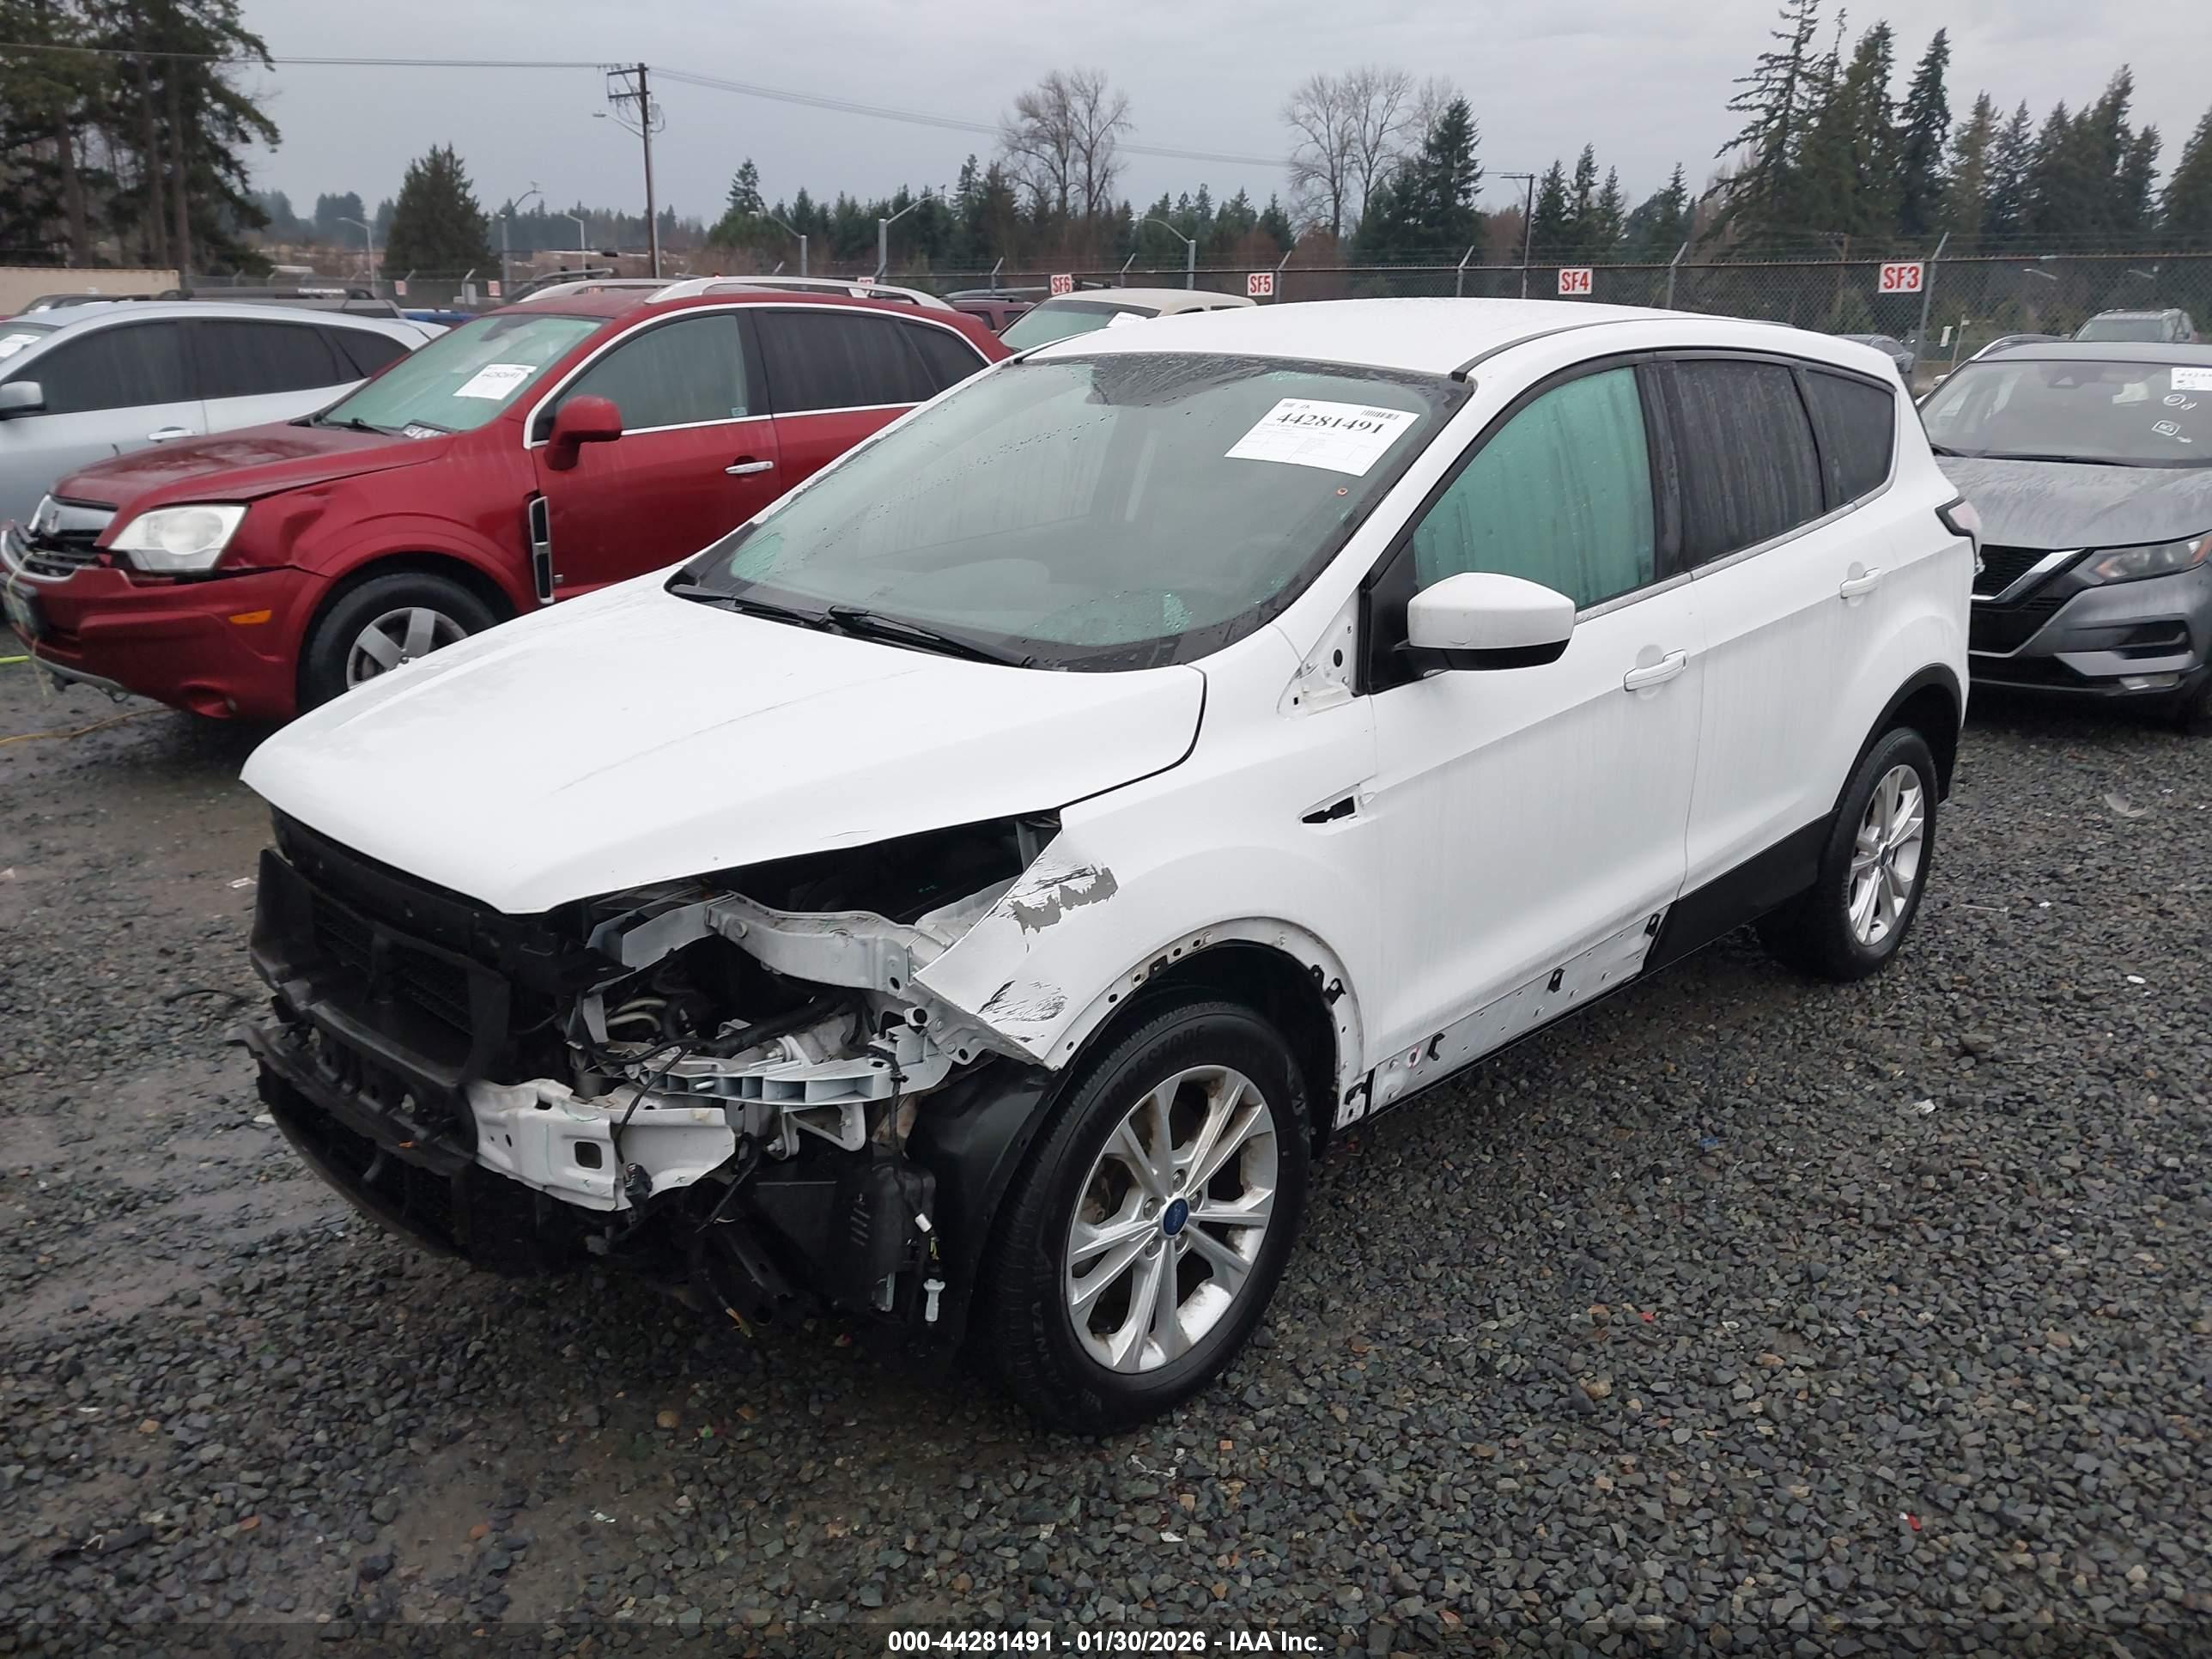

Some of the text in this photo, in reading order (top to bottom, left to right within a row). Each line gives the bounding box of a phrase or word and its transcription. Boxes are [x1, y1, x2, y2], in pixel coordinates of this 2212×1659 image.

[1052, 276, 1071, 293] SF6
[1249, 275, 1271, 293] SF5
[1561, 271, 1589, 292] SF4
[1882, 265, 1920, 289] SF3
[1276, 412, 1385, 434] 44281491
